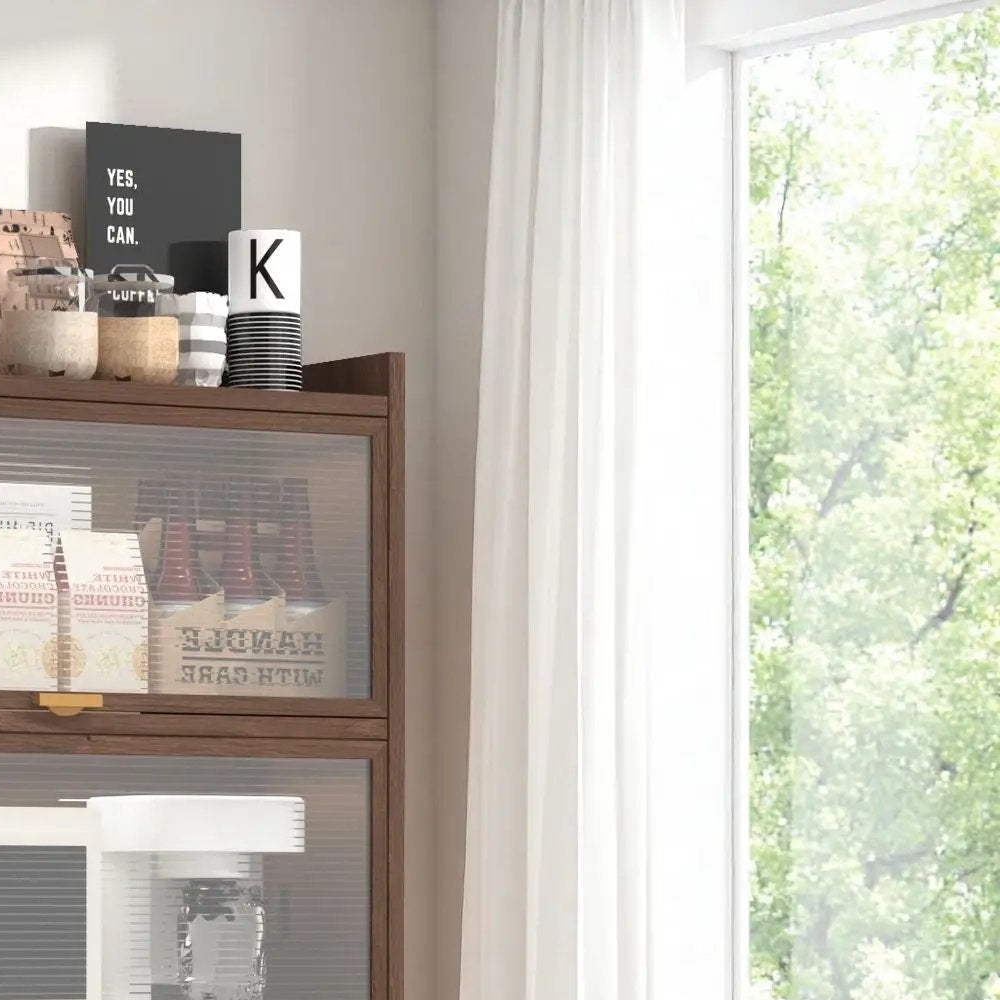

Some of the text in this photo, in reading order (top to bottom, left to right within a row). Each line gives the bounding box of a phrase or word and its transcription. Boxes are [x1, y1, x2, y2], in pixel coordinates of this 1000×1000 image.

[106, 167, 138, 190] YES,
[106, 196, 134, 216] YOU
[106, 225, 139, 245] CAN.
[249, 238, 285, 299] K
